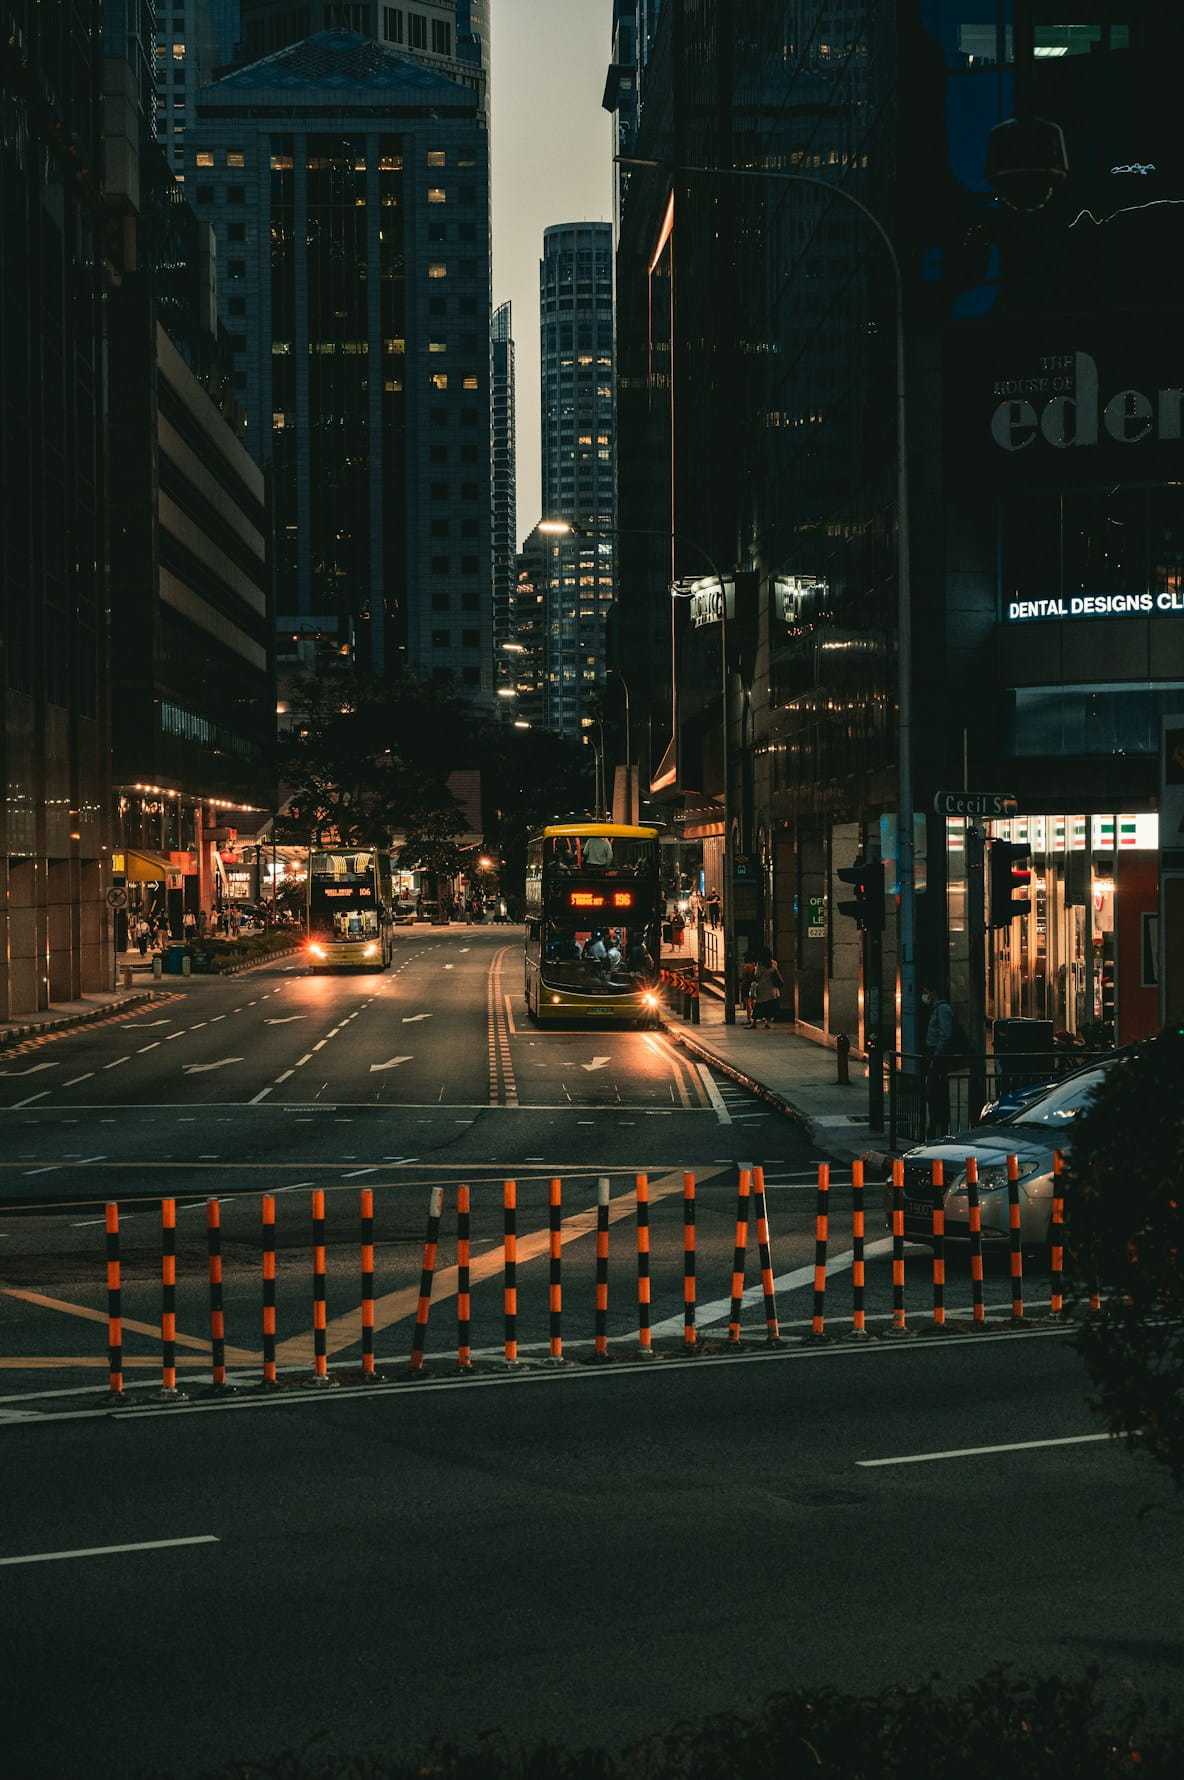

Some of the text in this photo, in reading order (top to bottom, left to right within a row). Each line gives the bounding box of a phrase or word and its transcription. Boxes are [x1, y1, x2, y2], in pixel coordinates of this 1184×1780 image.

[1010, 592, 1184, 619] DENTAL DESIGNS CL
[946, 795, 1009, 813] Cecil St
